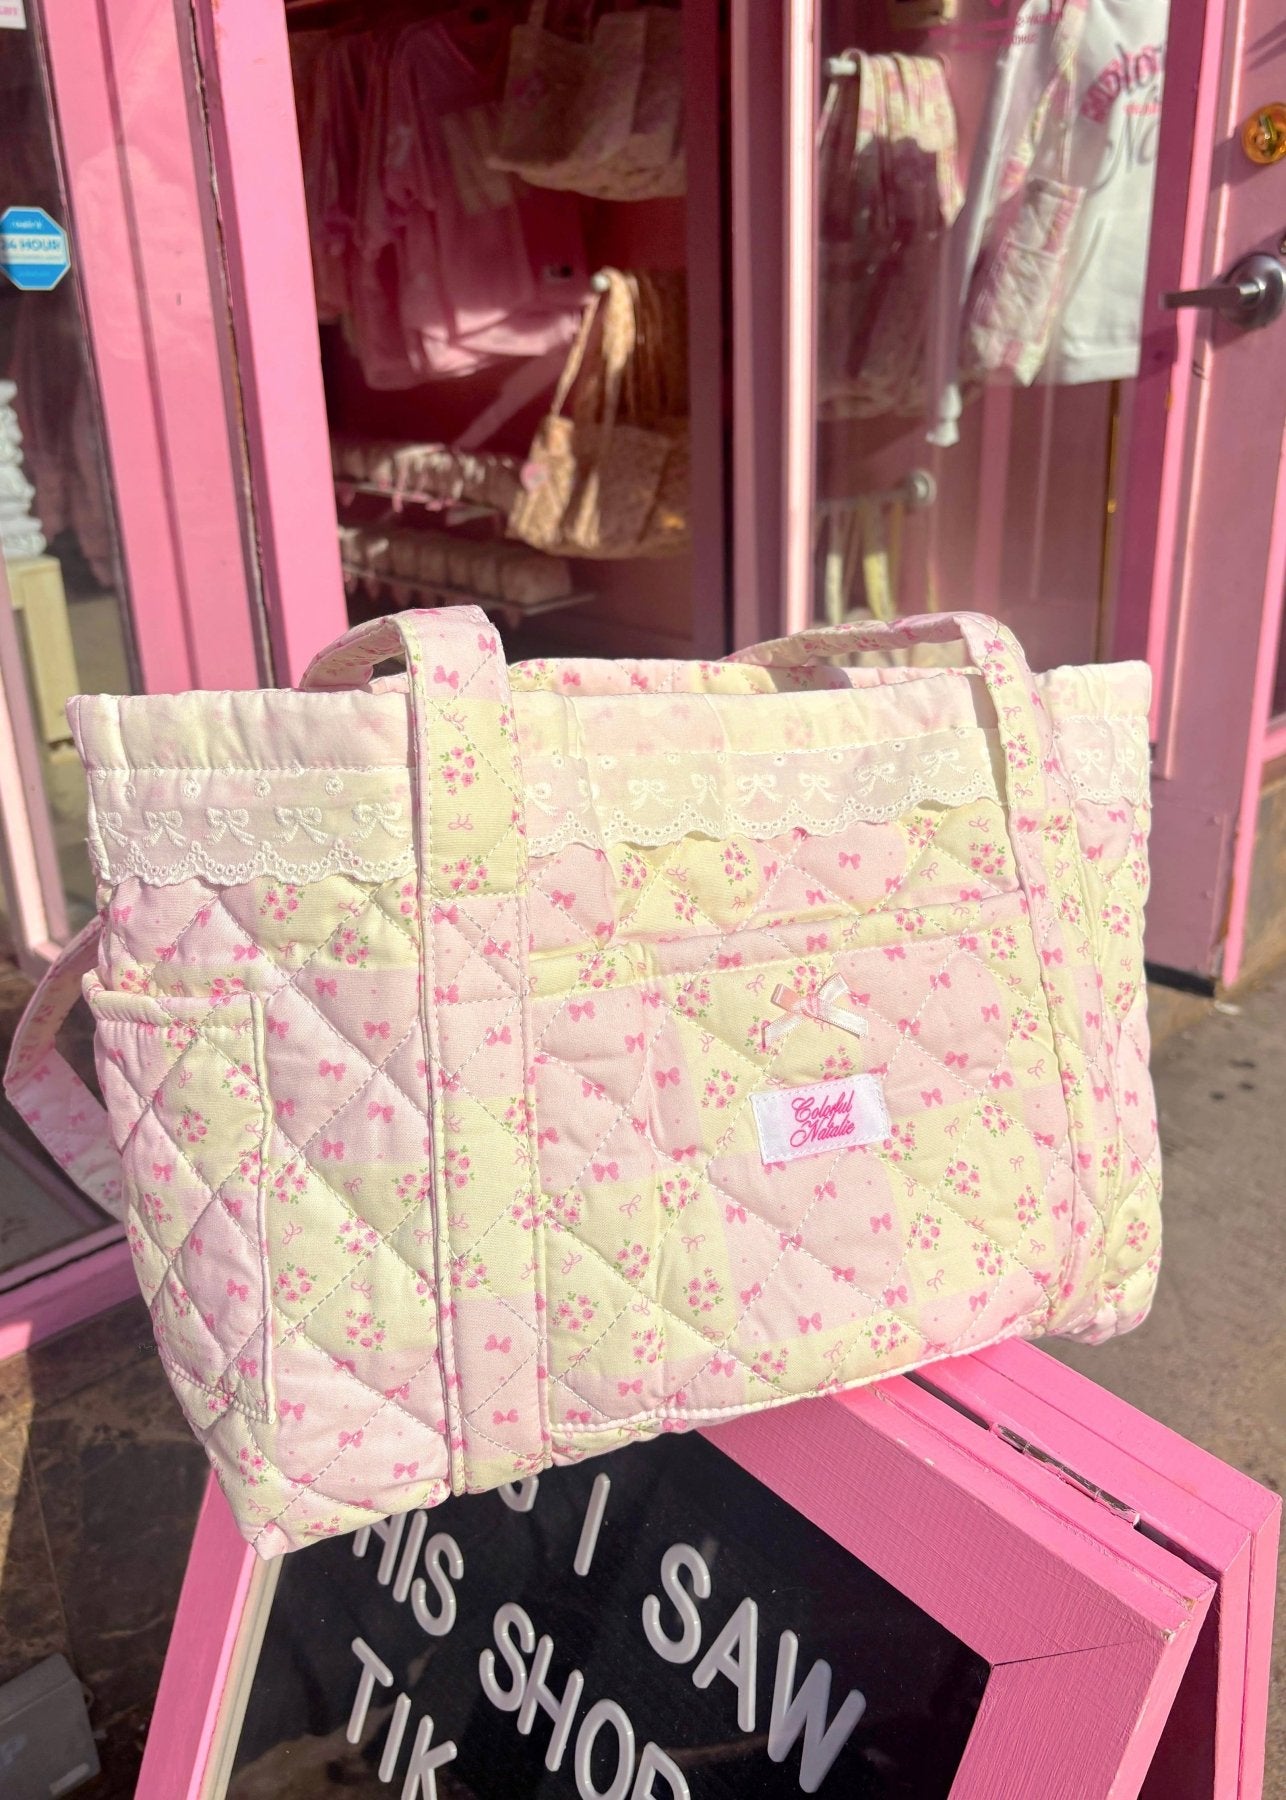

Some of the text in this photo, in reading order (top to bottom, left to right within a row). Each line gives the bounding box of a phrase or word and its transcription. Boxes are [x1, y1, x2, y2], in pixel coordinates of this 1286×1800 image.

[789, 1113, 855, 1148] Natalie
[791, 1089, 855, 1122] Colorful
[573, 1472, 867, 1793] I SAW
[346, 1637, 457, 1800] TIK
